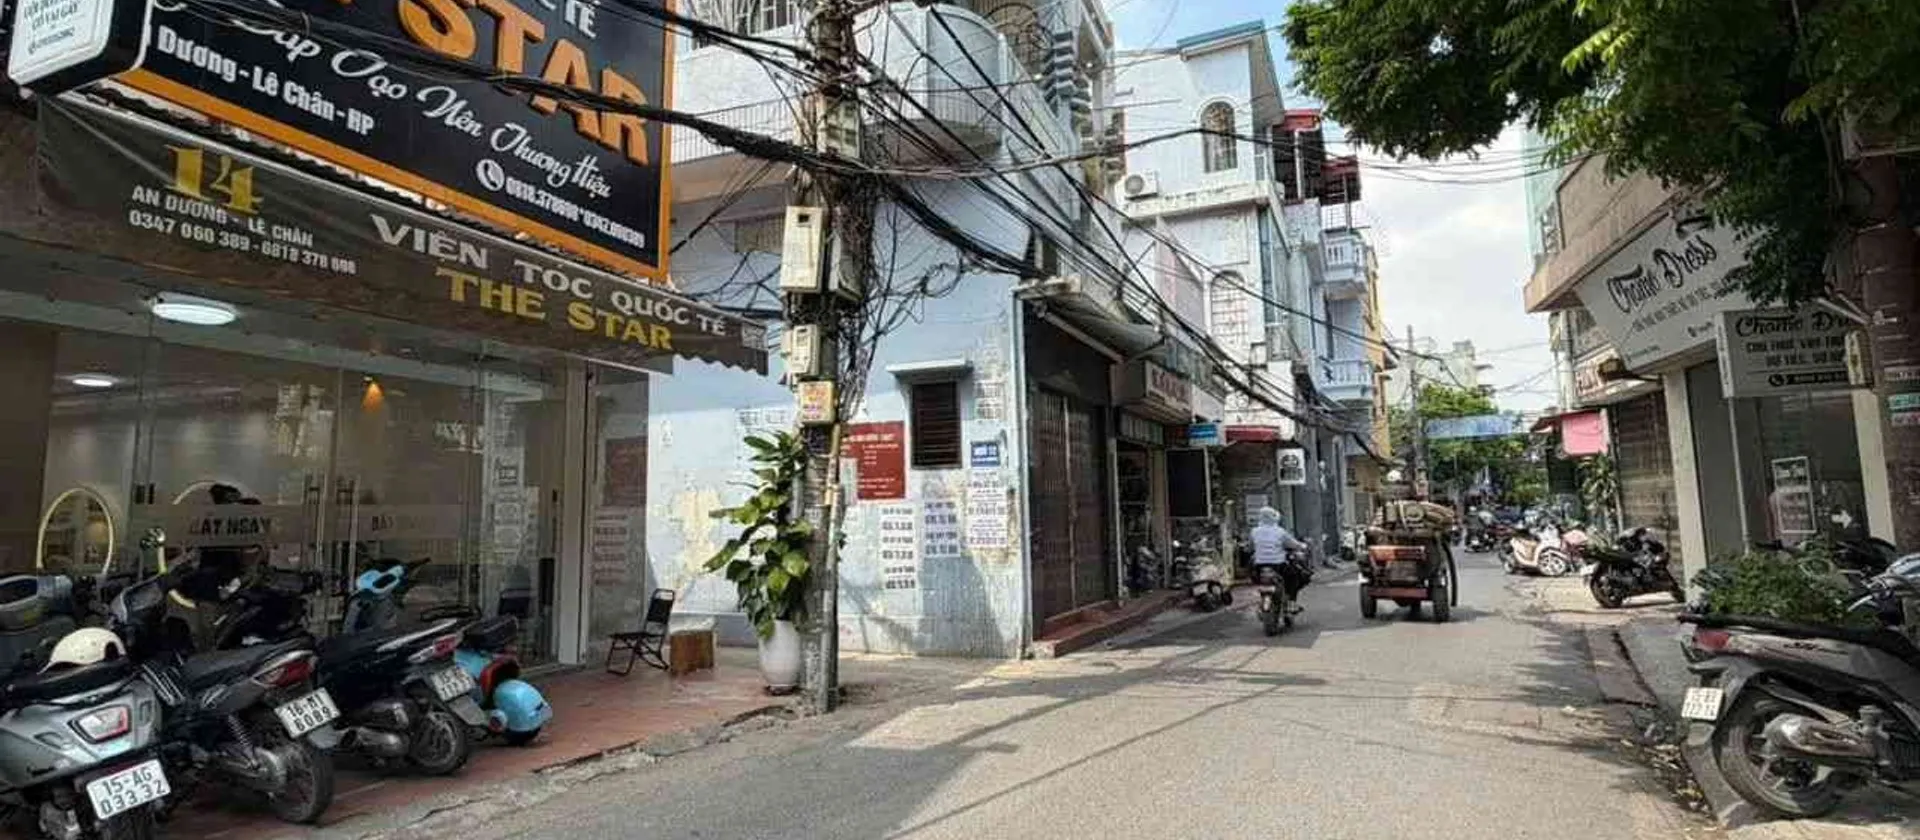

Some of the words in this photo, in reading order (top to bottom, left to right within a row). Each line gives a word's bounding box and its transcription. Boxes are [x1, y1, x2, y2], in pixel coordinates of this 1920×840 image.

[158, 24, 238, 84] Dương
[251, 66, 279, 97] Lê
[283, 81, 335, 121] Chân
[347, 106, 375, 136] HP
[398, 0, 650, 167] STAR
[129, 209, 174, 234] 0347
[131, 184, 161, 207] AN
[163, 144, 264, 215] 14
[370, 213, 489, 271] VIỆN
[514, 258, 594, 299] TÓC
[610, 287, 690, 326] QUỐC
[434, 265, 547, 322] THE
[566, 299, 674, 352] STAR
